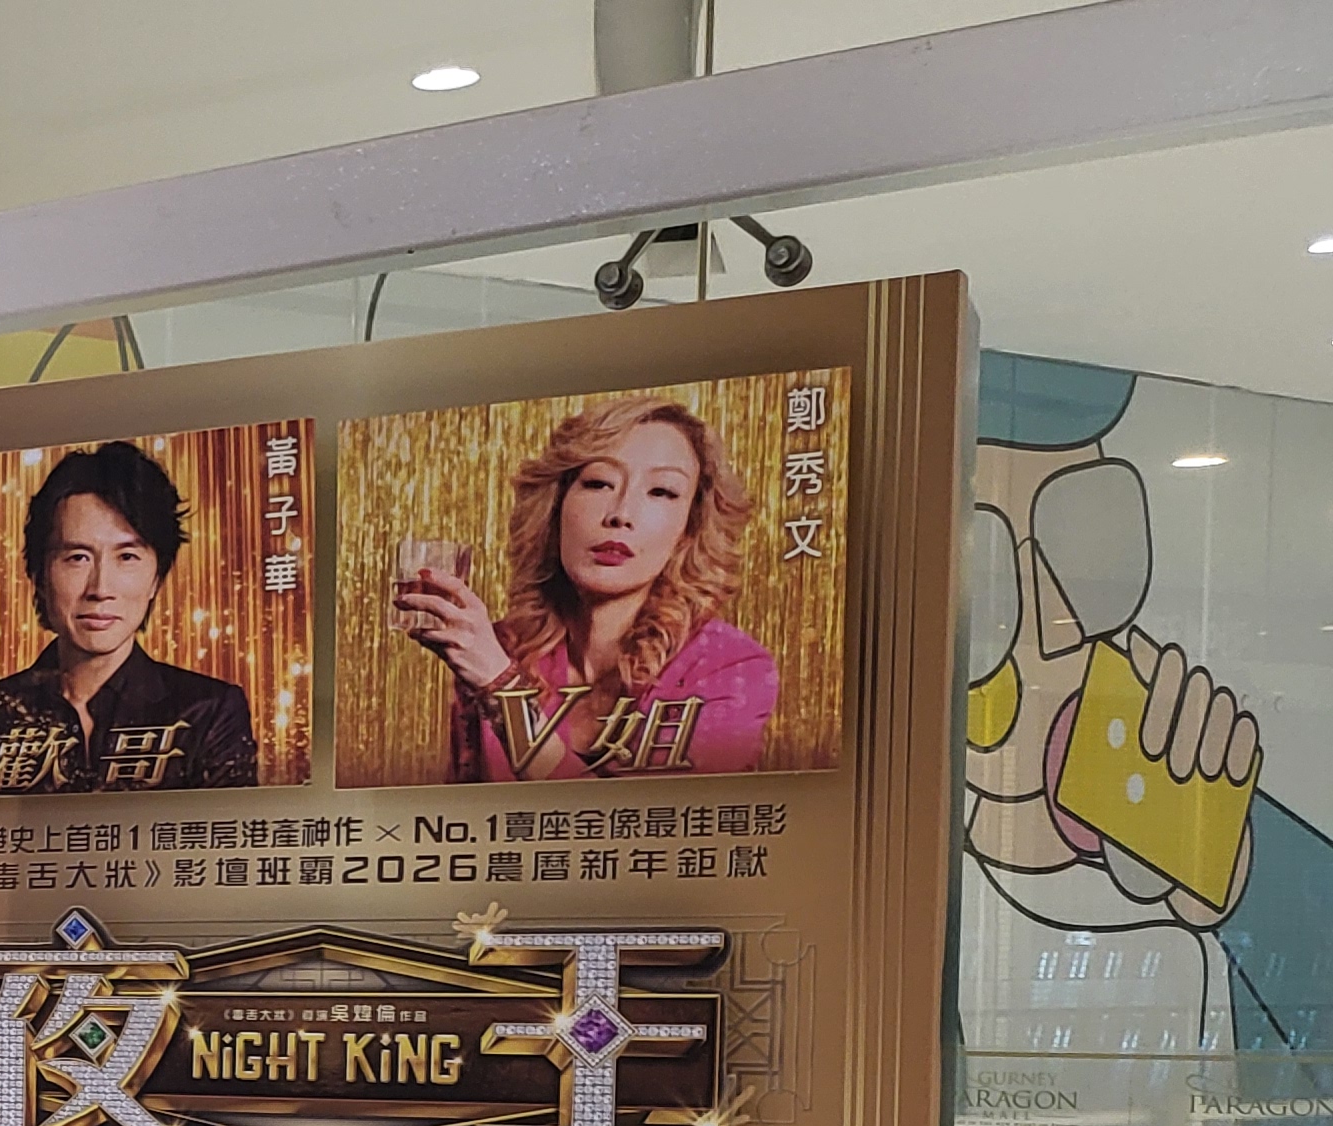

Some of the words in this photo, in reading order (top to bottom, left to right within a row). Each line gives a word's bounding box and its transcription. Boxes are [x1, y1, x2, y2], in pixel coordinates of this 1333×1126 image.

[265, 435, 298, 595] 黃子華
[784, 388, 827, 560] 鄭秀文
[959, 1089, 1078, 1110] ARAGON
[978, 1071, 1056, 1086] GURNEY
